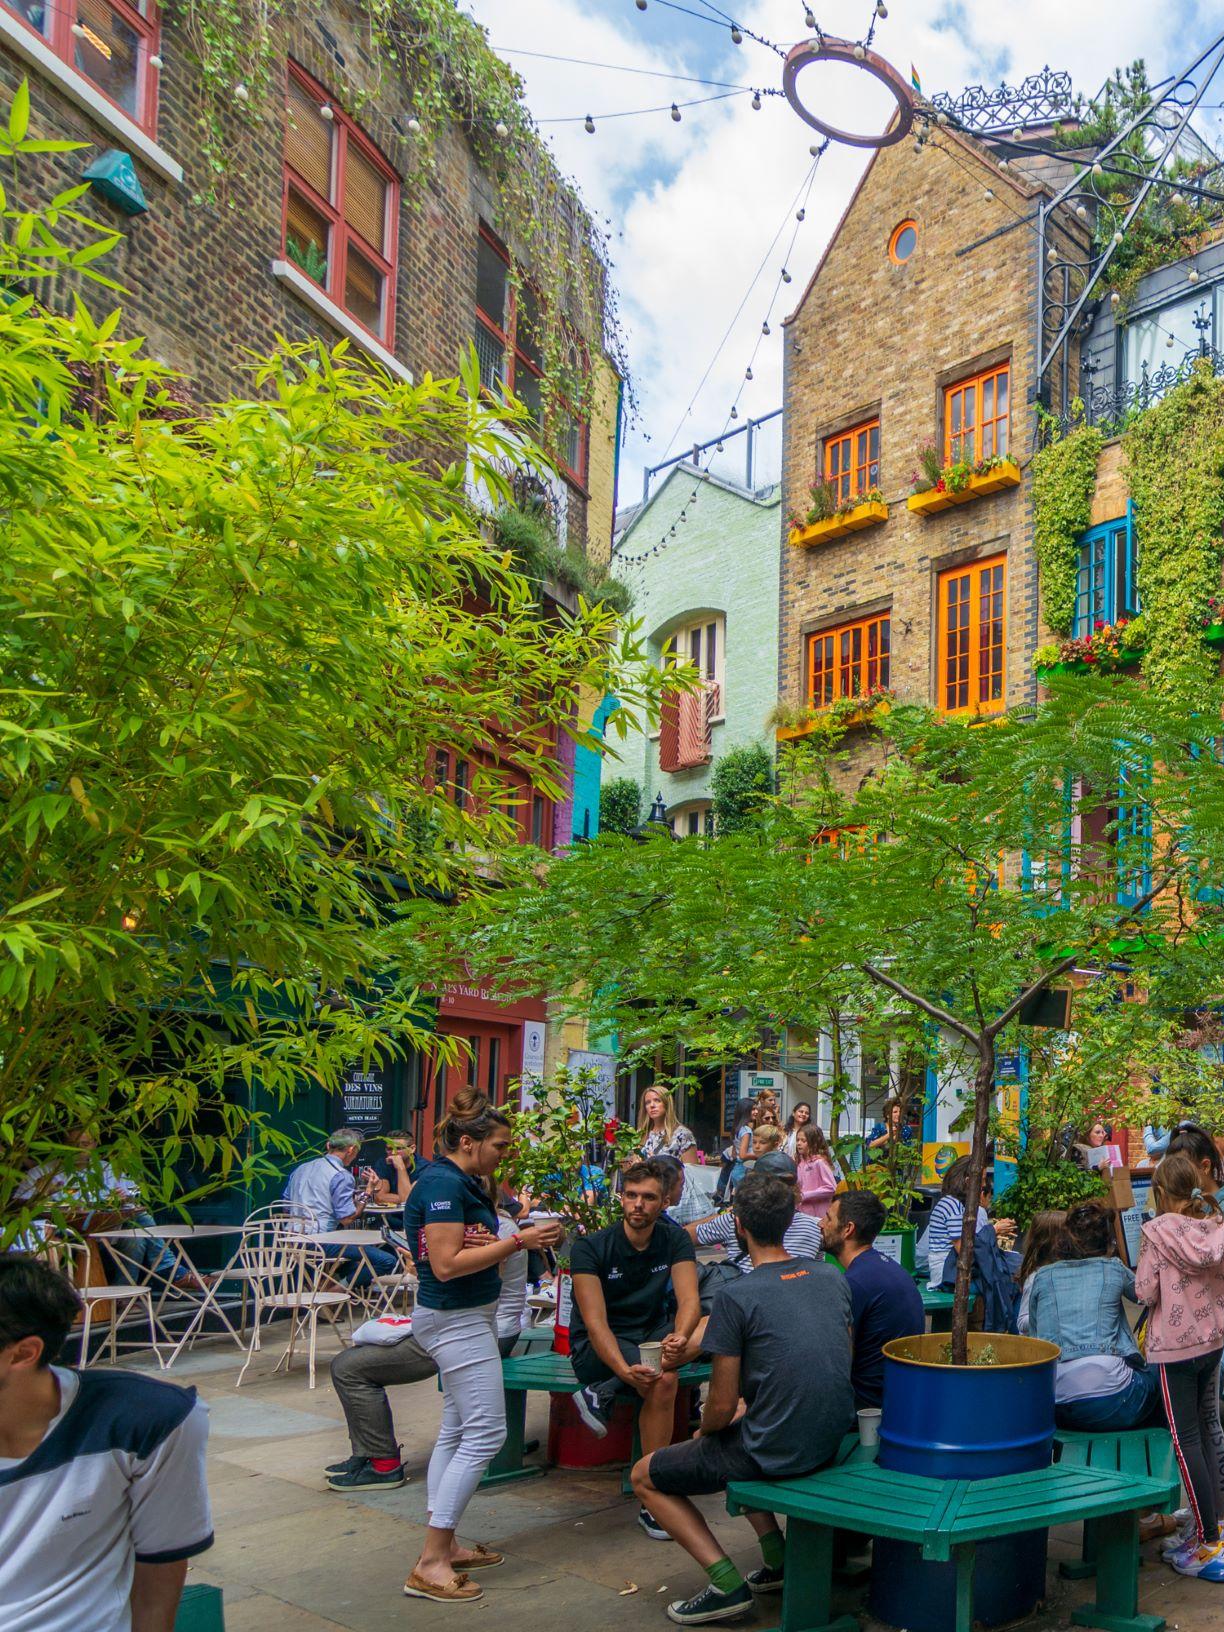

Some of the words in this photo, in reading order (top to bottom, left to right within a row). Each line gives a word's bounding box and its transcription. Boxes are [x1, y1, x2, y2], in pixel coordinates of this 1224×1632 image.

[459, 985, 480, 998] YARD
[344, 1083, 361, 1092] DES
[364, 1083, 383, 1093] VINS
